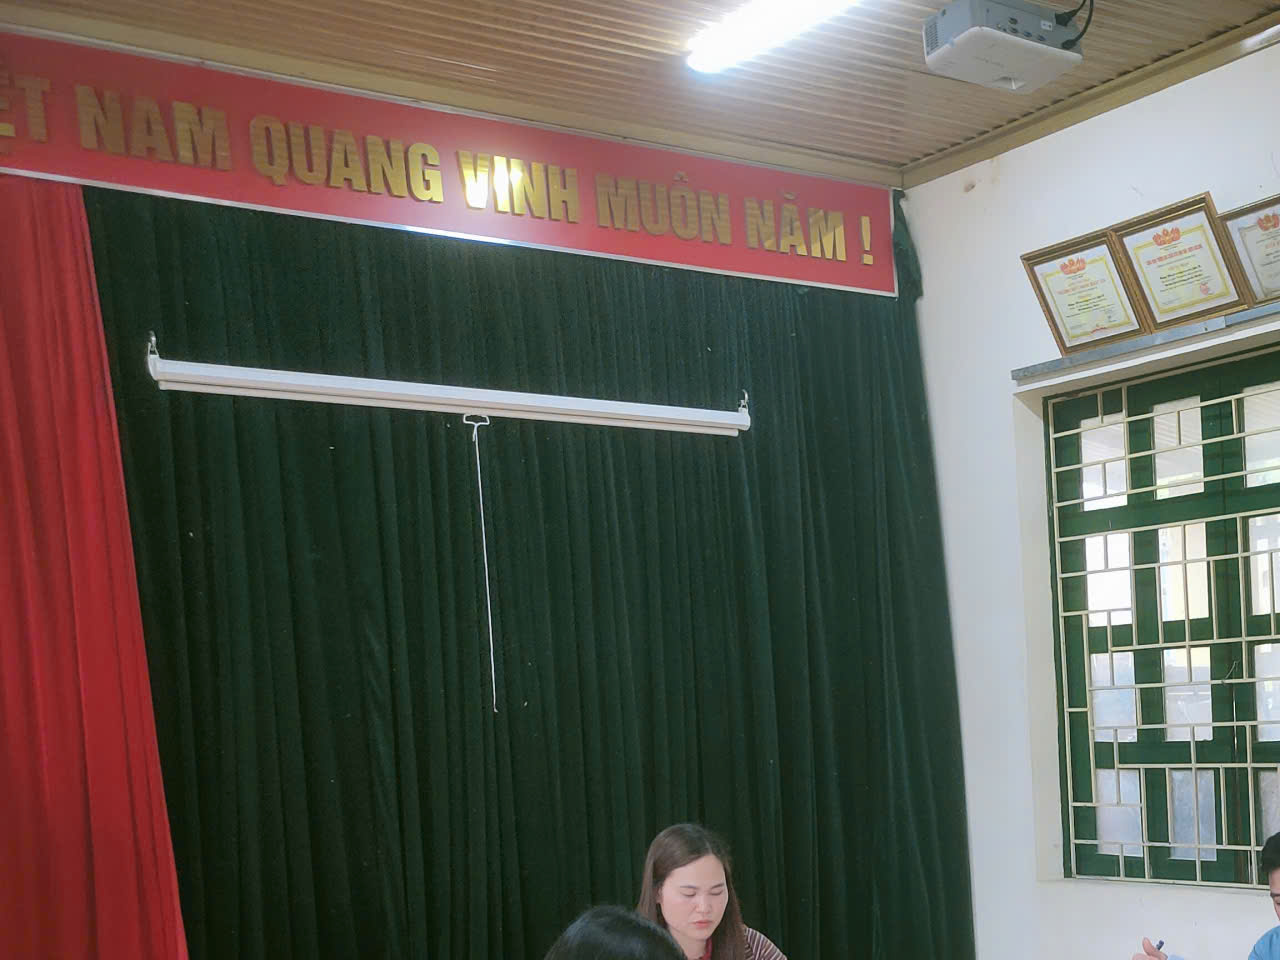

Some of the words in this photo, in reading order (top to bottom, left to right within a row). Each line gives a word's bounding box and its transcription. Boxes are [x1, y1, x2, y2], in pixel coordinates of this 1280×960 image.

[74, 83, 232, 171] NAM
[249, 113, 444, 205] QUANG
[456, 149, 581, 224] VINH
[594, 171, 733, 245] MUÔN
[745, 192, 848, 262] NĂM
[859, 215, 875, 266] !
